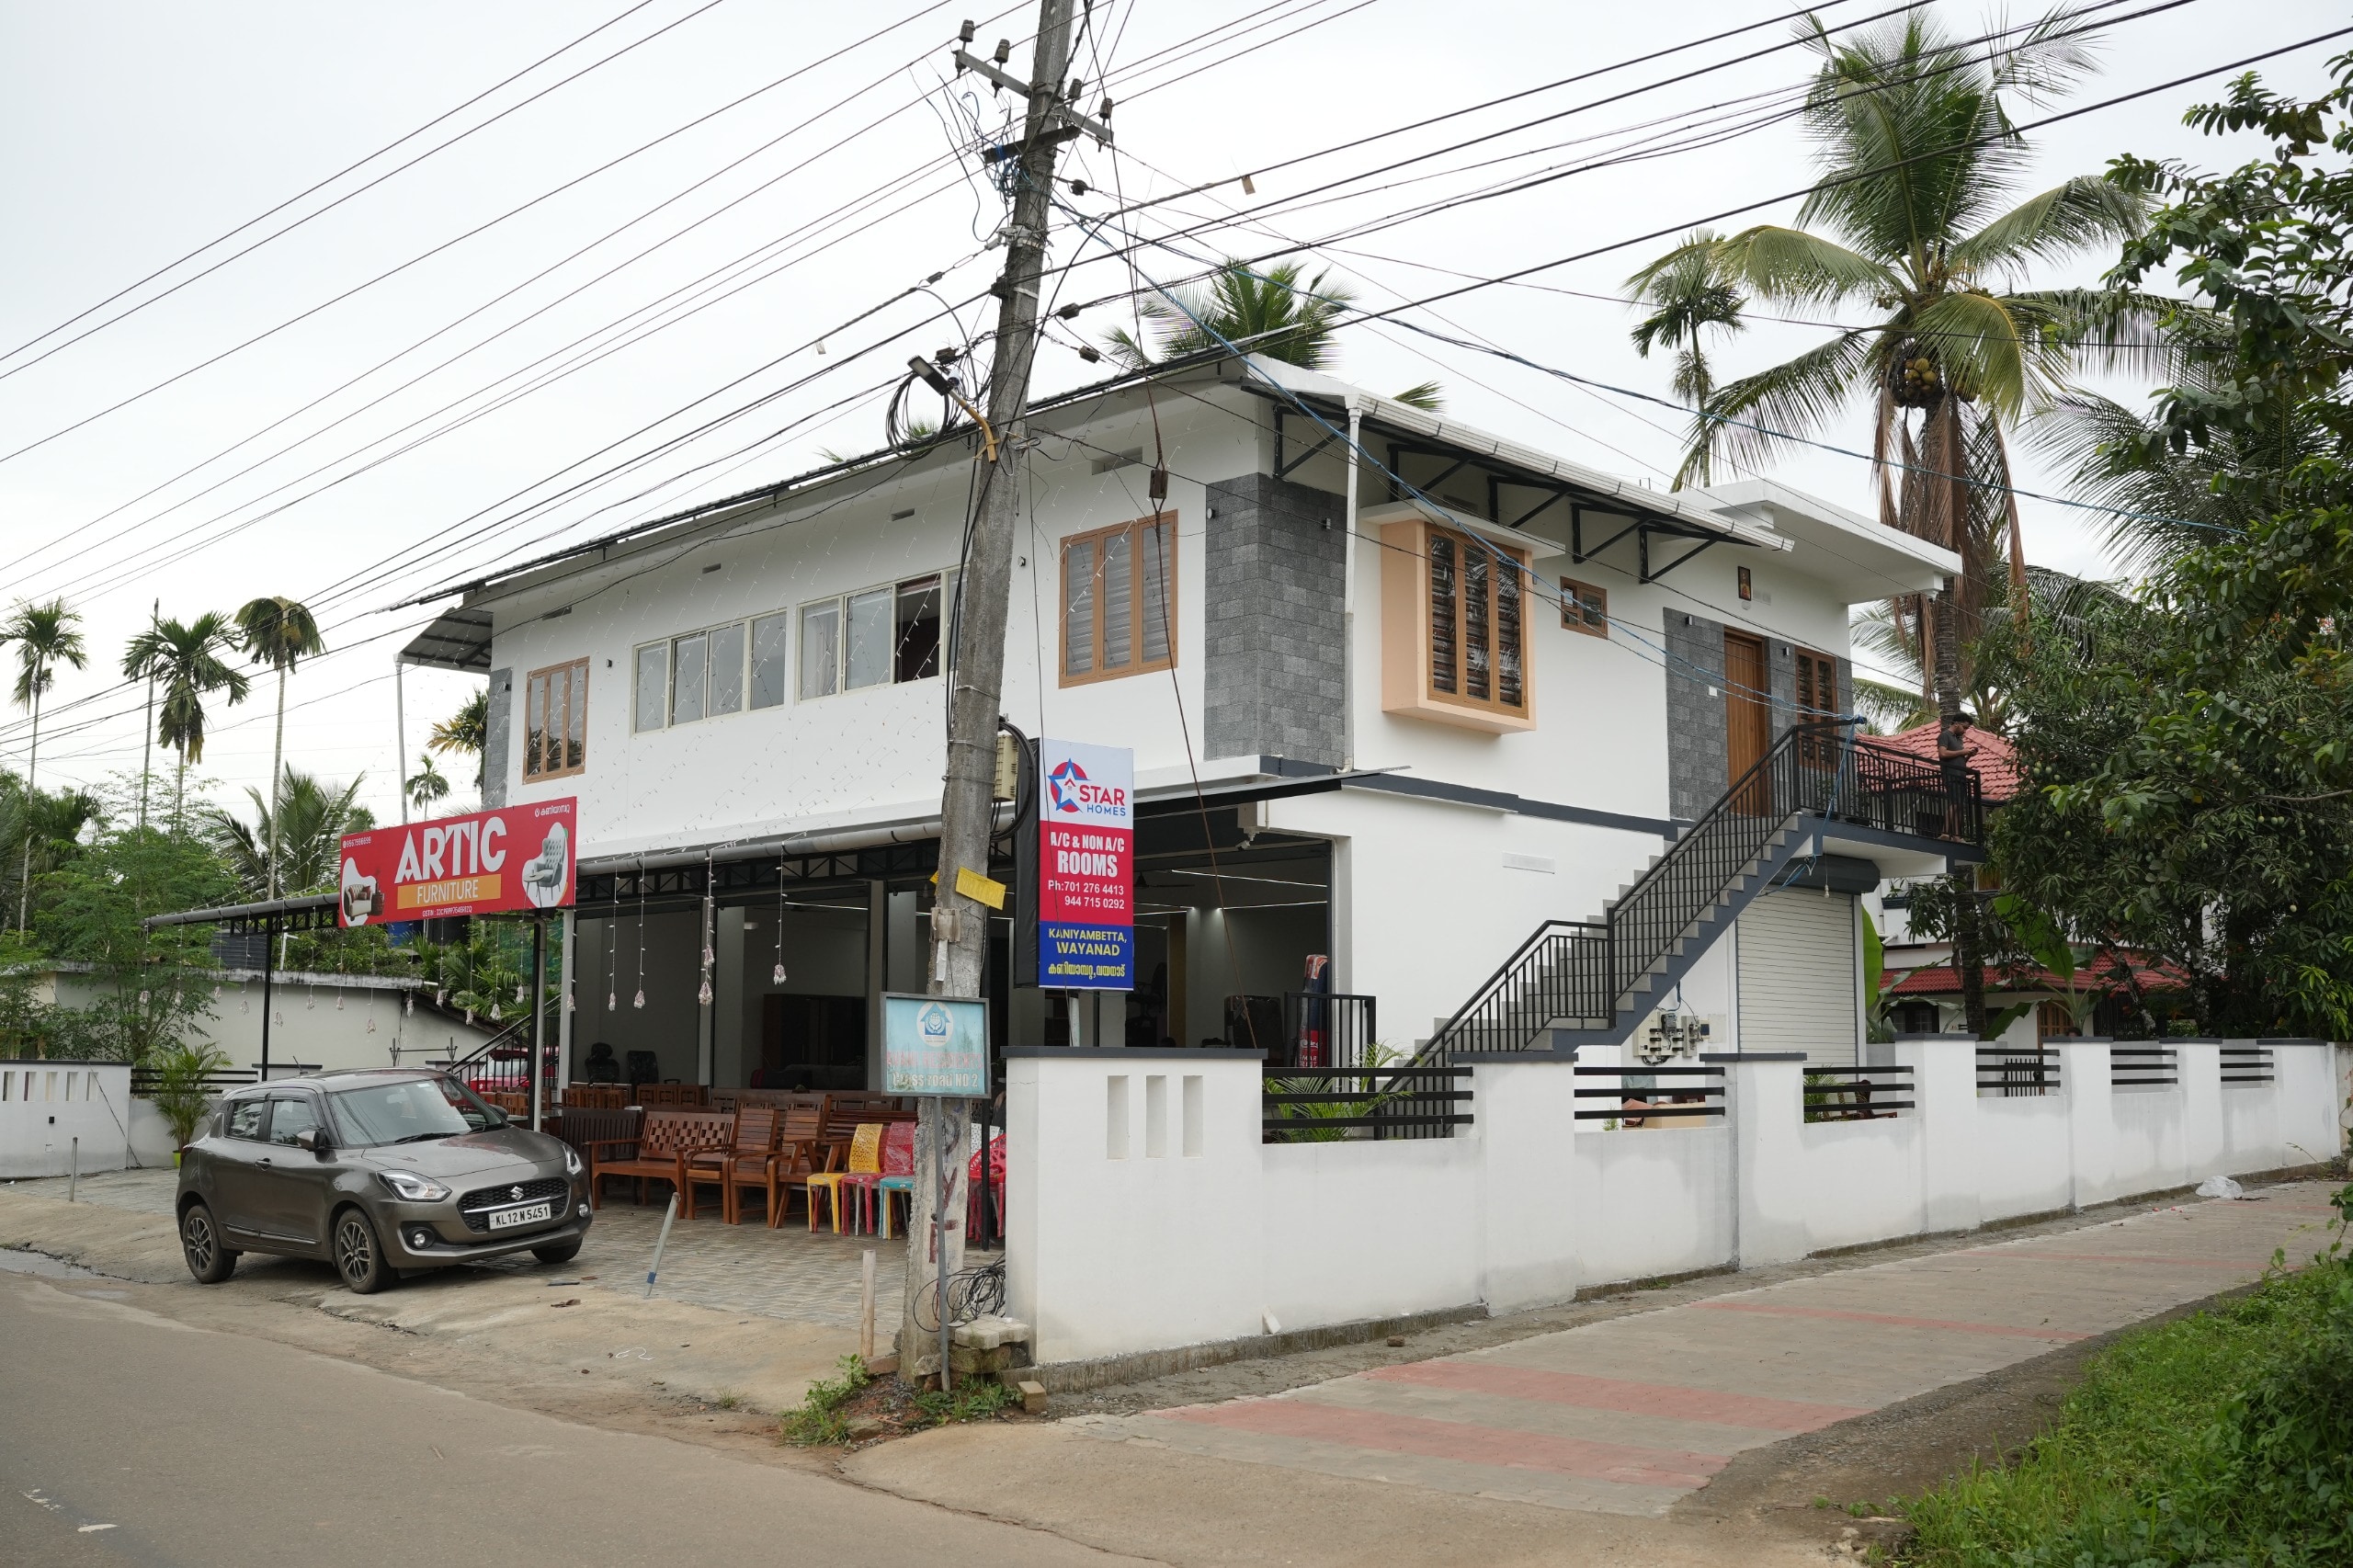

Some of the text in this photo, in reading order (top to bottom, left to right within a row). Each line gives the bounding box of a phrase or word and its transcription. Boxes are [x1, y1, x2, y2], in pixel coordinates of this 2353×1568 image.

[1079, 784, 1125, 806] STAR
[1086, 804, 1126, 816] HOMES
[394, 816, 507, 884] ARTIC
[1051, 832, 1125, 852] A/C & NON A/C
[1057, 850, 1118, 877] ROOMS
[416, 880, 479, 903] FURNITURE
[1083, 882, 1100, 893] 276
[1102, 884, 1124, 895] 4413
[1064, 895, 1125, 909] 944 715 0292
[1049, 928, 1127, 943] KANIYAMBETTA,
[1056, 941, 1120, 957] WAYANAD
[926, 1074, 953, 1086] road
[955, 1073, 969, 1087] NO
[972, 1074, 978, 1087] 2
